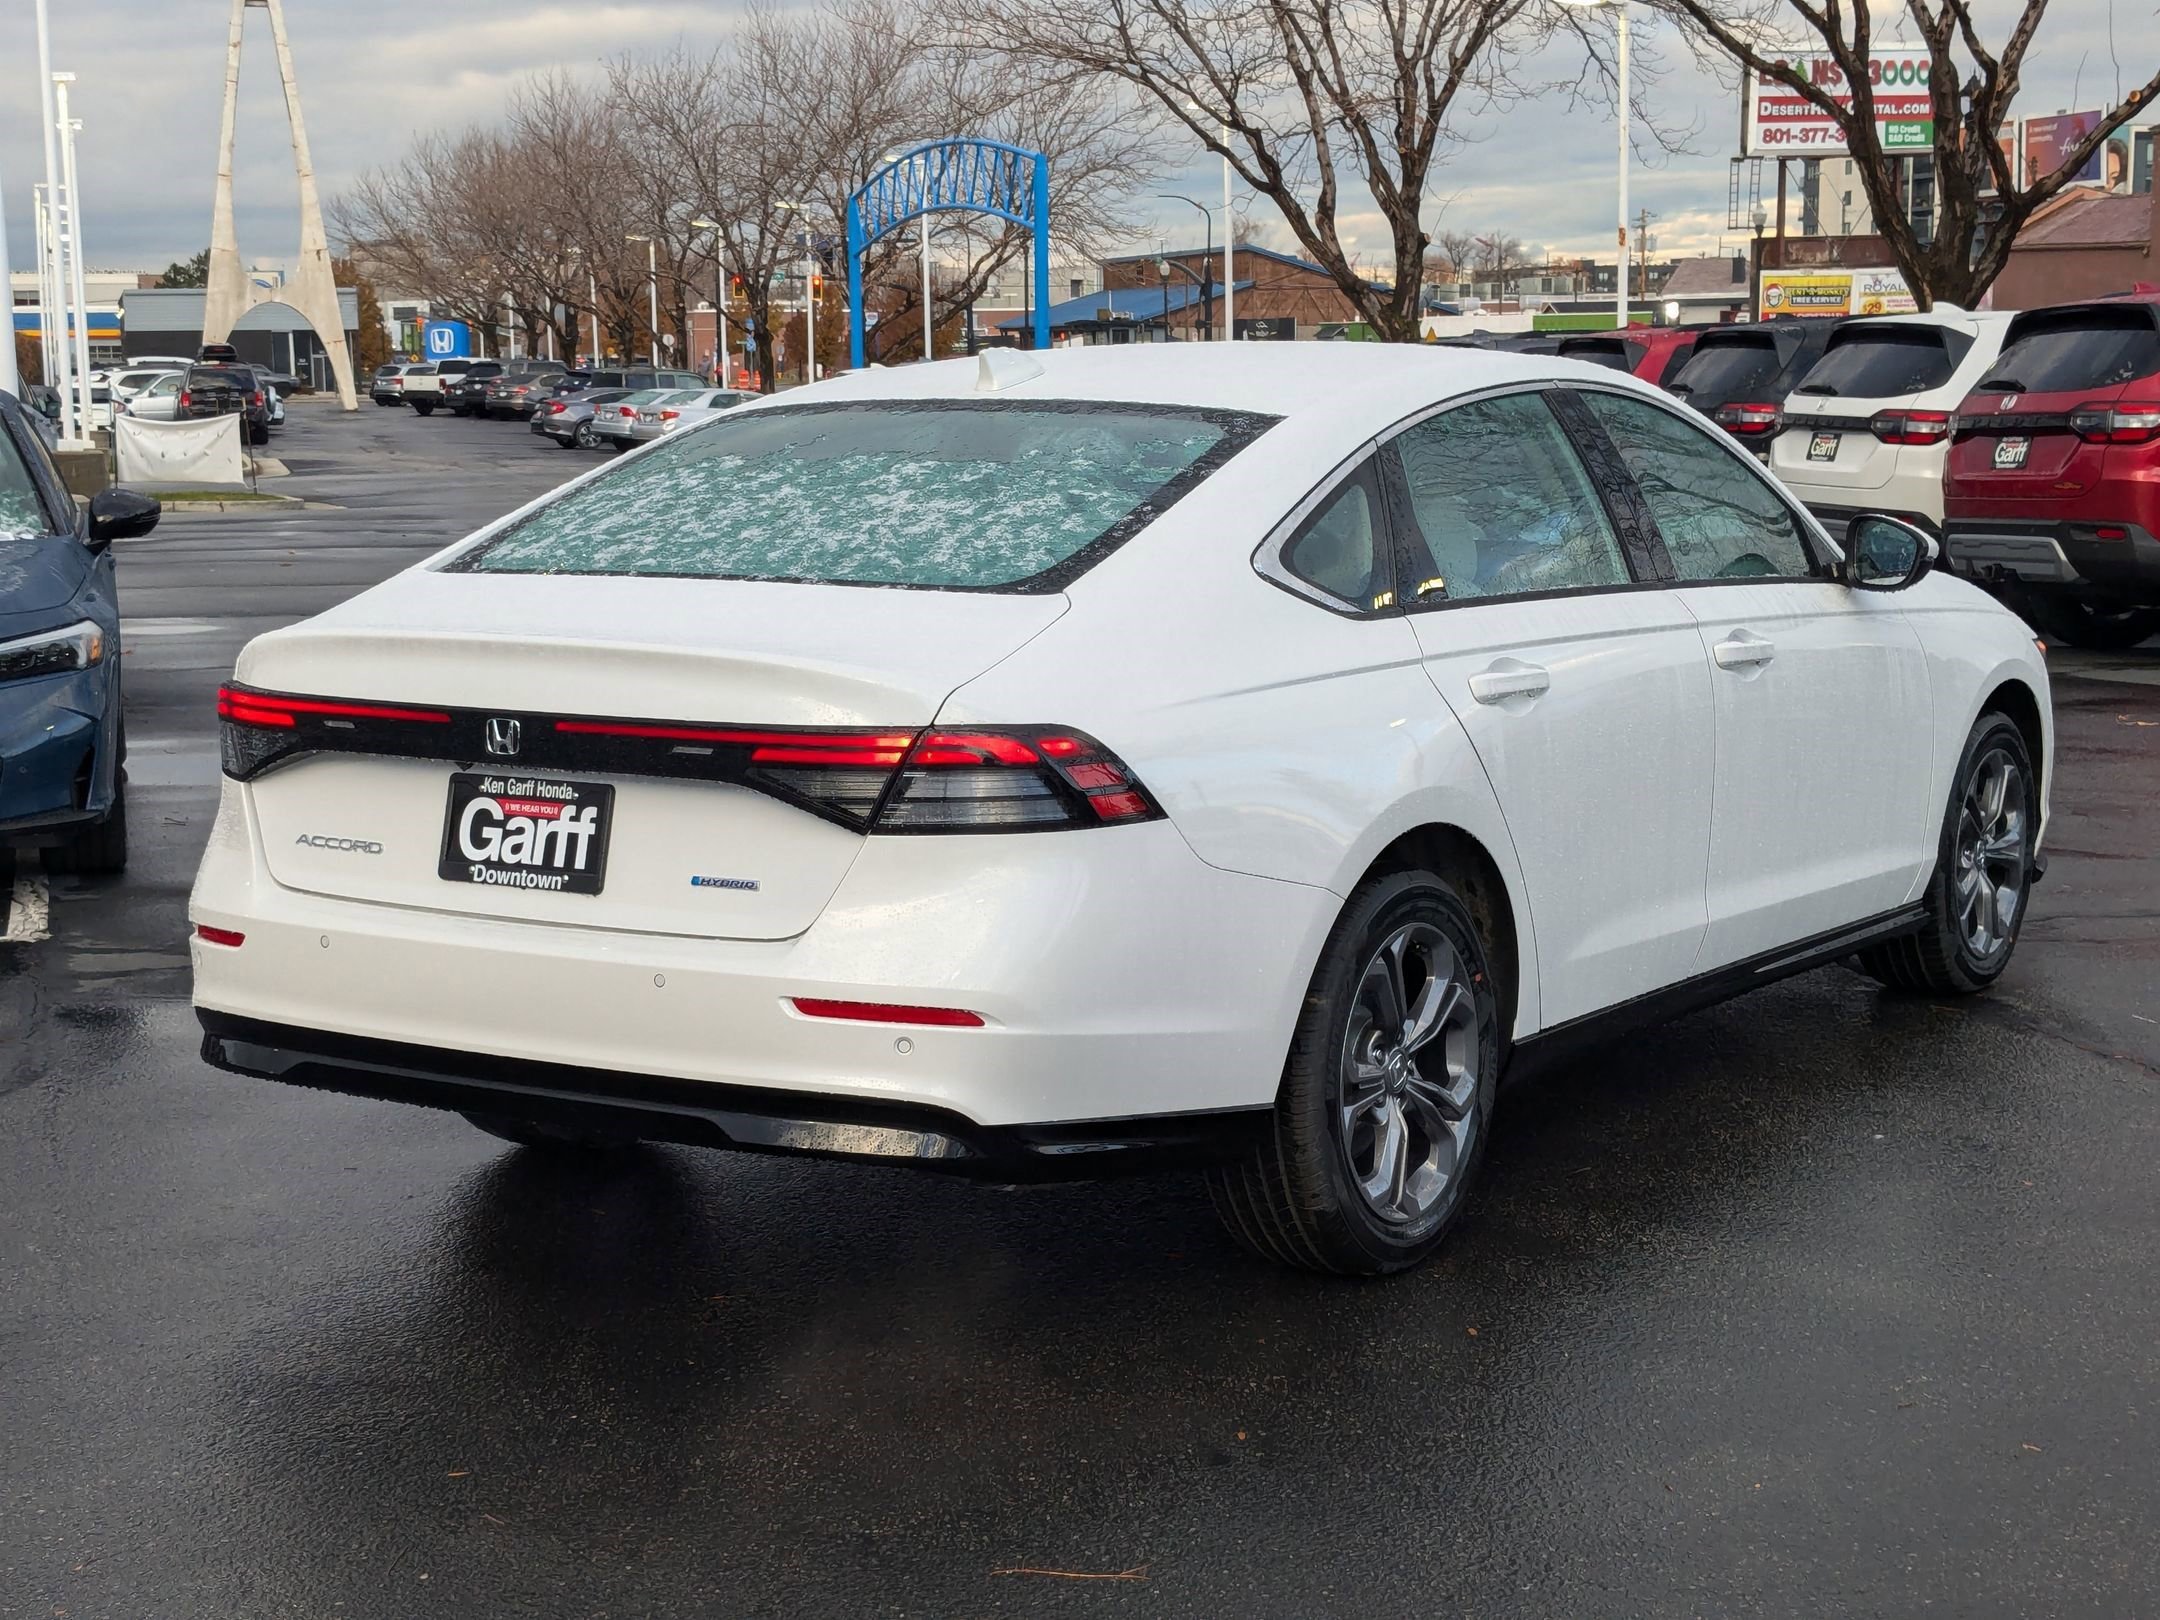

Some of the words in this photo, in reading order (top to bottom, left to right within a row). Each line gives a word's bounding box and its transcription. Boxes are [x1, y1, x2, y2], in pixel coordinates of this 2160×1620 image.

[1762, 127, 1847, 144] 801-377-3
[1864, 282, 1905, 292] ROYAL
[484, 776, 504, 794] Ken
[507, 778, 535, 797] Garff
[537, 781, 573, 799] Honda
[509, 803, 521, 812] WE
[521, 804, 540, 813] HEAR
[540, 805, 554, 814] YOU
[459, 797, 598, 870] Garff
[296, 834, 383, 854] ACCORD
[473, 864, 562, 890] Downtown
[700, 877, 758, 890] HYBRID
